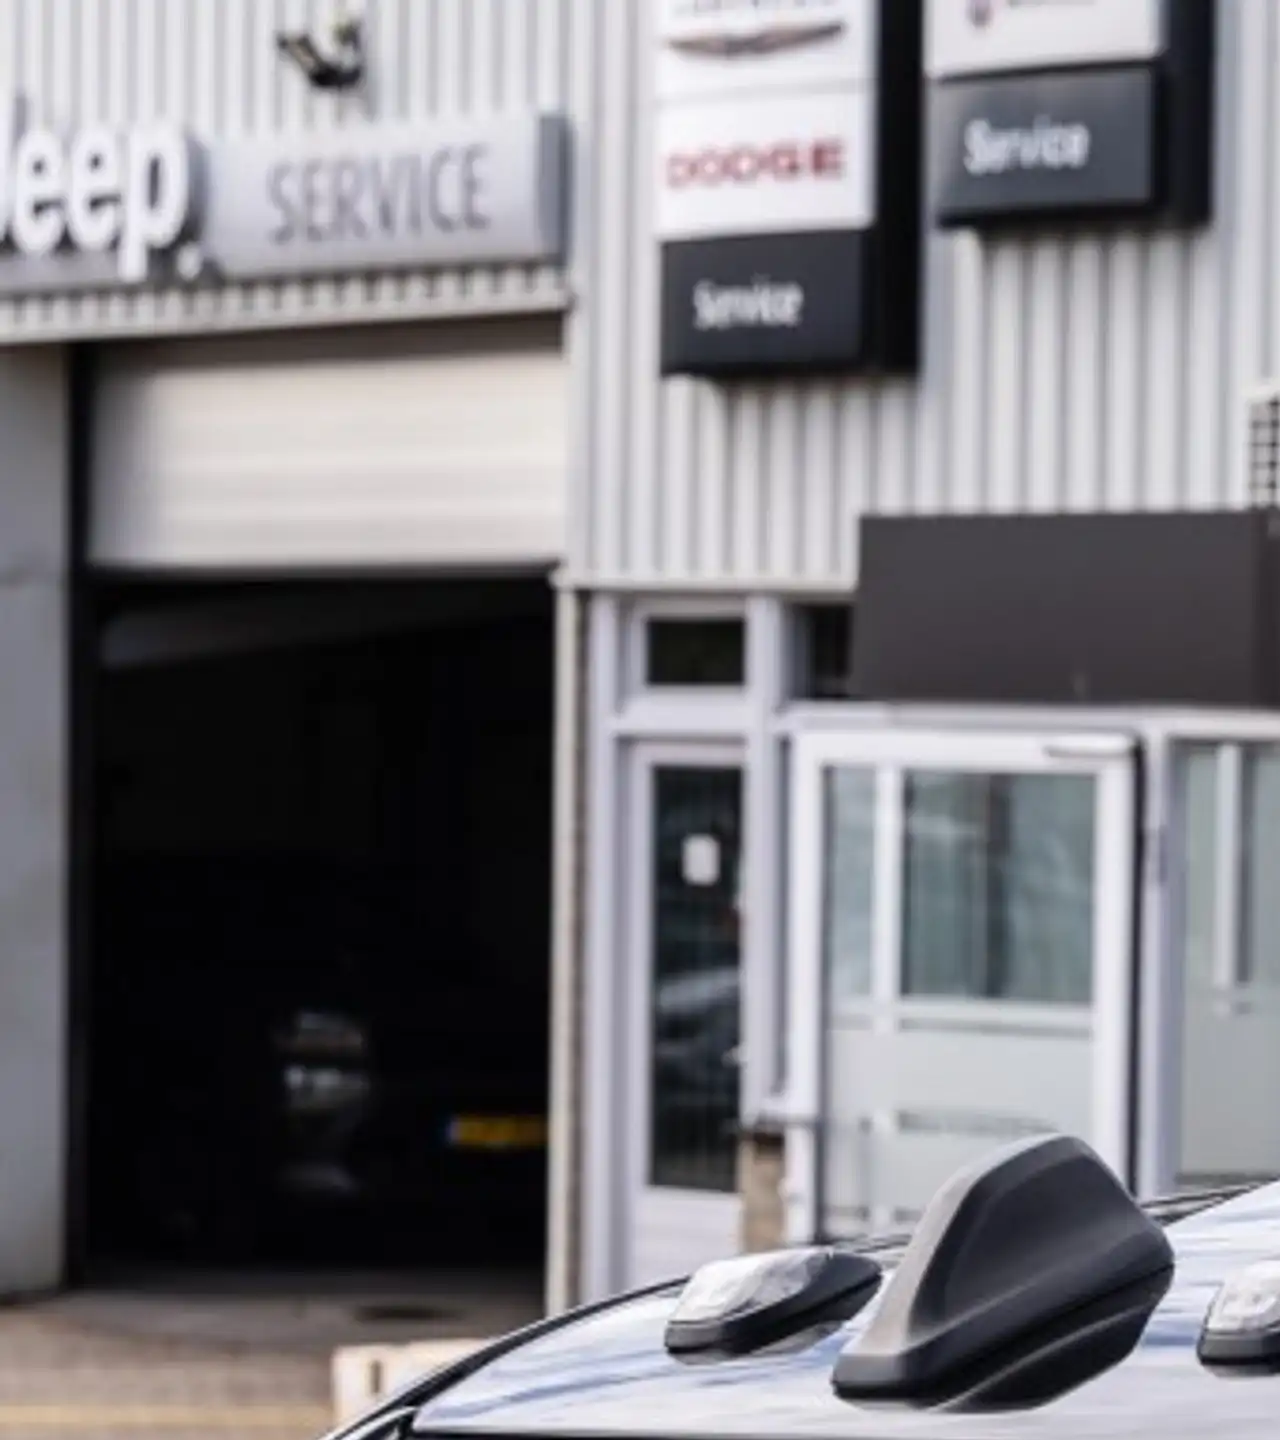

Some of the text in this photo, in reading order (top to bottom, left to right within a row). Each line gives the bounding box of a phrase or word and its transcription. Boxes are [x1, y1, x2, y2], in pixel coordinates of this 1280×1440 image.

[665, 136, 845, 190] DODGE
[962, 114, 1090, 176] Service
[265, 140, 490, 245] SERVICE
[692, 272, 804, 331] Service
